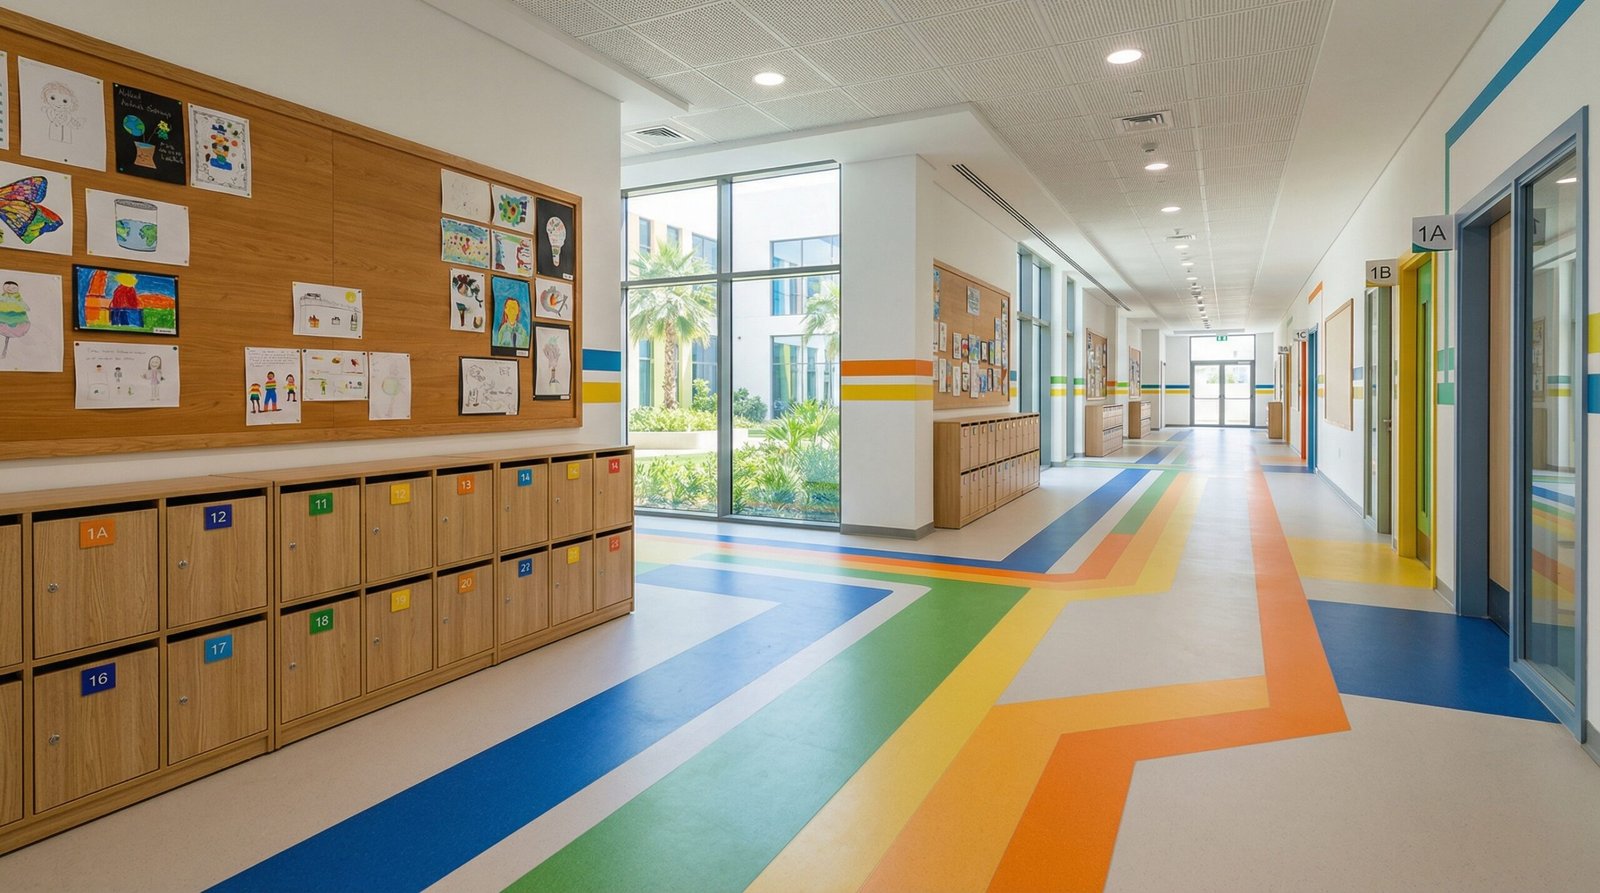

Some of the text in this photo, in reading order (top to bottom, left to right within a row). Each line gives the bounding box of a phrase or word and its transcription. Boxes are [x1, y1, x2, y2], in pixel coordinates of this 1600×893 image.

[1418, 225, 1447, 243] 1A
[1371, 266, 1392, 280] 1B
[395, 489, 406, 498] 12
[315, 498, 327, 511] 11
[211, 511, 227, 523] 12
[87, 527, 108, 540] 1A
[461, 579, 472, 589] 20
[316, 615, 329, 627] 18
[211, 642, 227, 656] 17
[89, 673, 108, 687] 16
